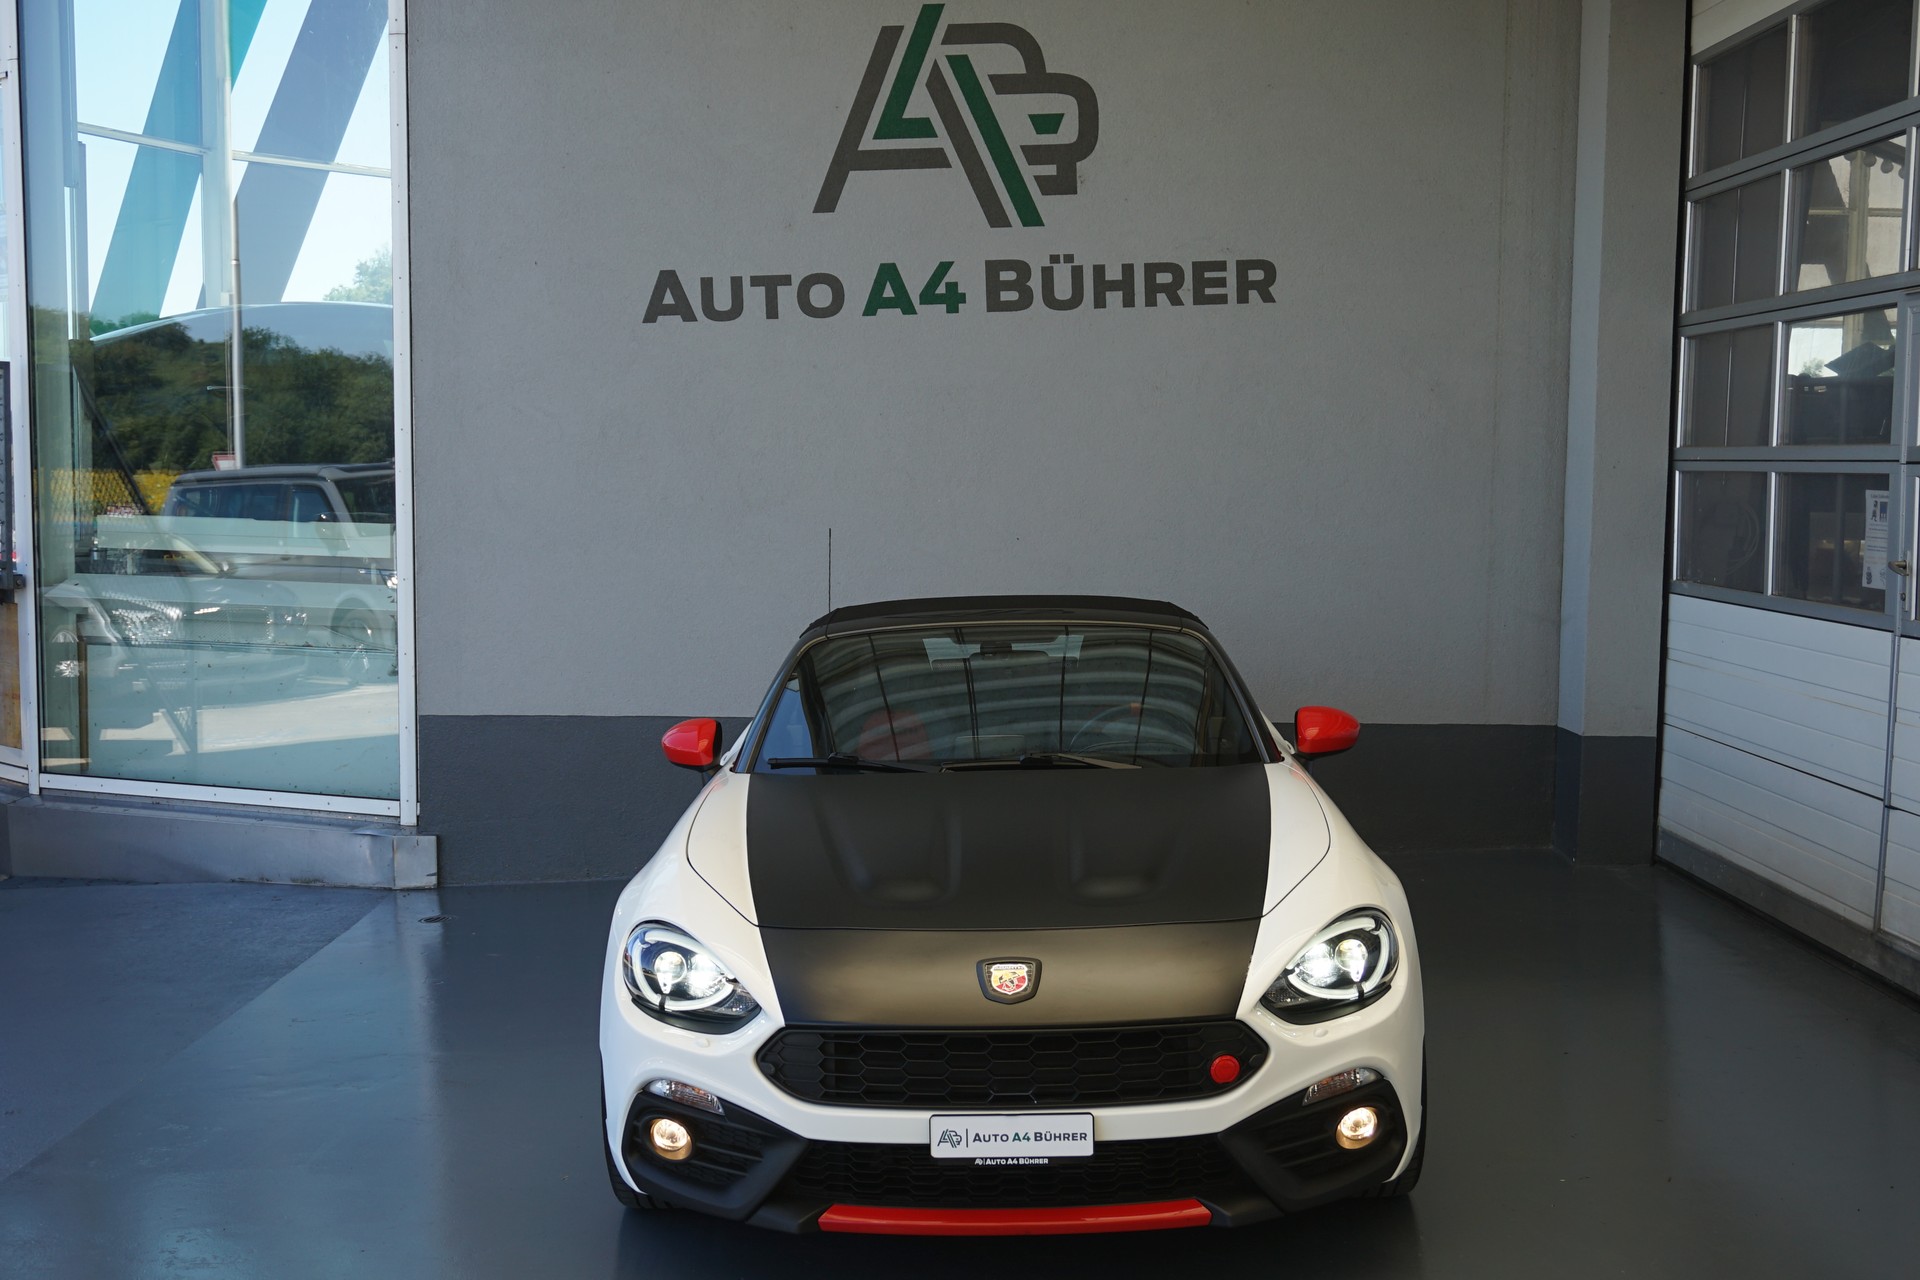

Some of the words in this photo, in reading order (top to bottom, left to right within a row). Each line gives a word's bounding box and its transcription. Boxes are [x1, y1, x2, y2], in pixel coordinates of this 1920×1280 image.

[641, 269, 845, 323] AUTO
[862, 260, 966, 317] A4
[984, 253, 1277, 313] BÜHRER
[973, 1132, 1009, 1143] AUTO
[1012, 1132, 1031, 1142] A4
[1034, 1131, 1088, 1142] BÜHRER
